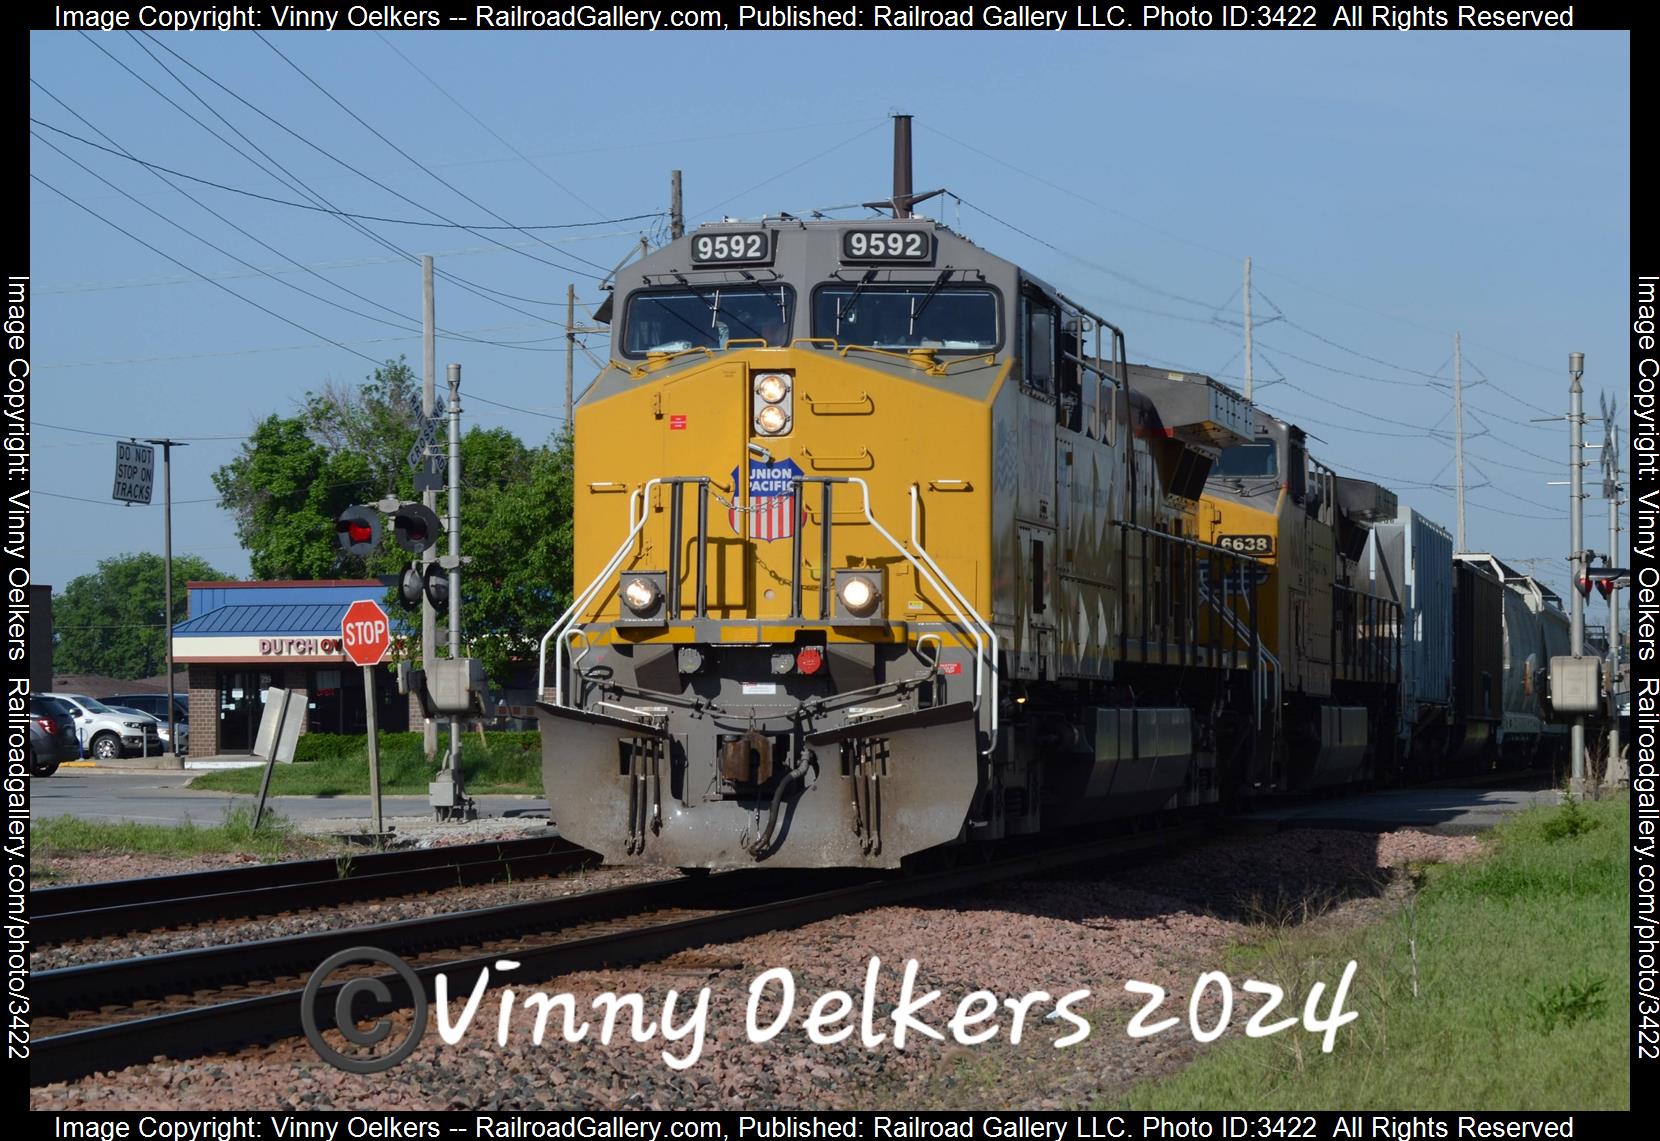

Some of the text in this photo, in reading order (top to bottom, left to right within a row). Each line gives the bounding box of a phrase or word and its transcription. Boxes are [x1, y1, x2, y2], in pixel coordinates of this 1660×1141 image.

[697, 234, 761, 260] 9592
[851, 232, 922, 257] 9592
[119, 445, 152, 464] DO NOT
[118, 464, 152, 482] STOP ON
[116, 481, 151, 500] TRACKS
[749, 480, 795, 492] ACIFIC
[1220, 537, 1268, 551] 6638
[345, 620, 386, 647] STOP
[259, 638, 318, 655] DUTCH
